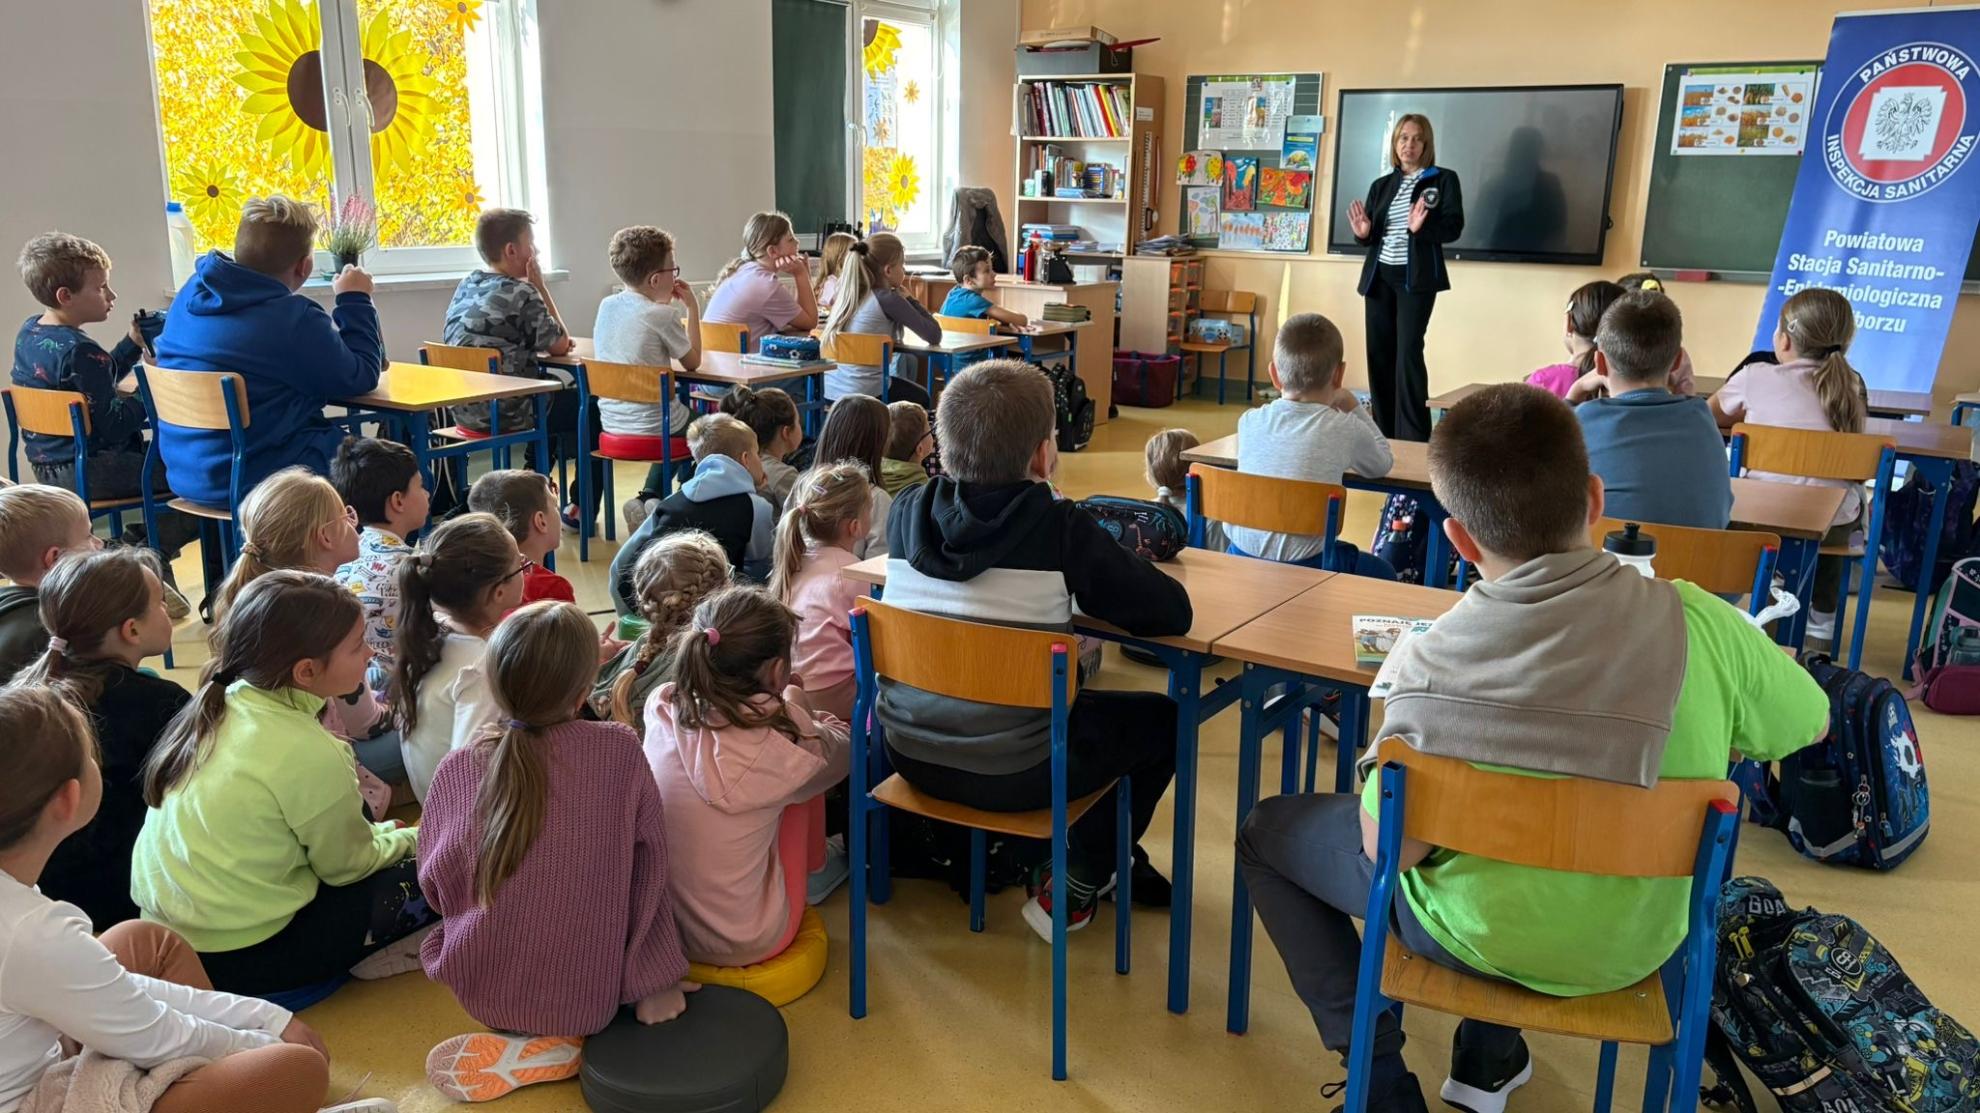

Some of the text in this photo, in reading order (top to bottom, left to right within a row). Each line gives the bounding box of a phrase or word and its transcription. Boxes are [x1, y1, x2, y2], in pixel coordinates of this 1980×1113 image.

[1859, 47, 1970, 83] PAŃSTWOWA
[1827, 134, 1975, 199] INSPEKCJA SANITARNA
[1823, 229, 1925, 253] Powiatowa
[1788, 253, 1945, 281] Stacja Sanitarno-
[1777, 278, 1944, 309] -Emiologiczna
